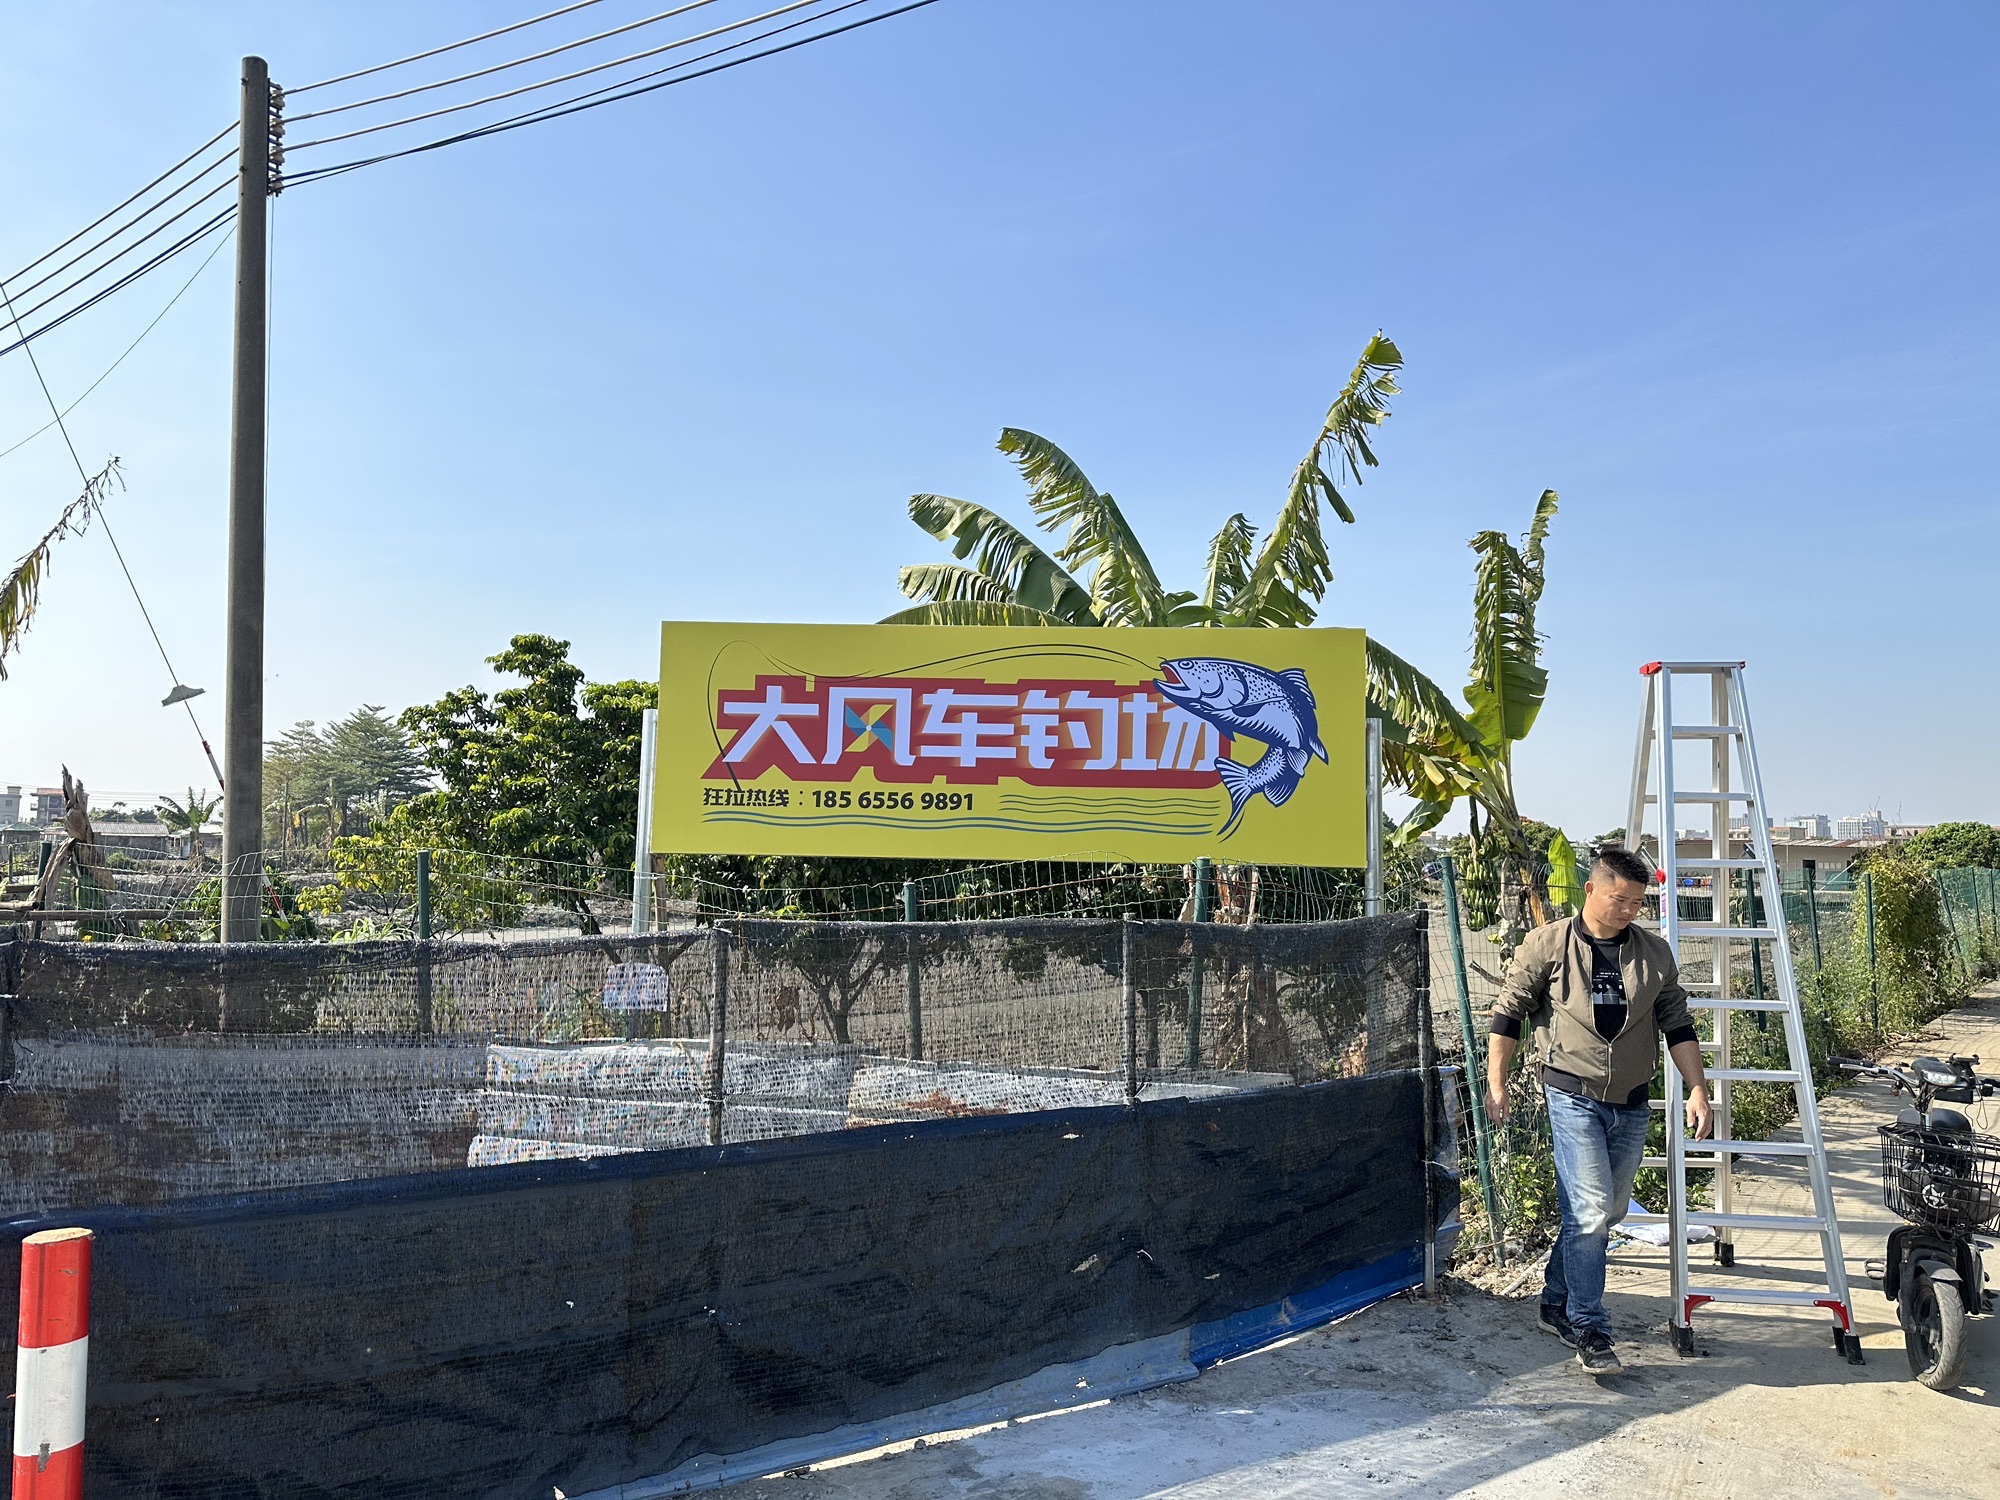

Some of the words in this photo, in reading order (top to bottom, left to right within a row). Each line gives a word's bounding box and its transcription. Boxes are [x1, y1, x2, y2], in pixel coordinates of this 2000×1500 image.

[722, 685, 1220, 772] 大风车钓场
[858, 791, 914, 809] 6556
[921, 792, 973, 811] 9891
